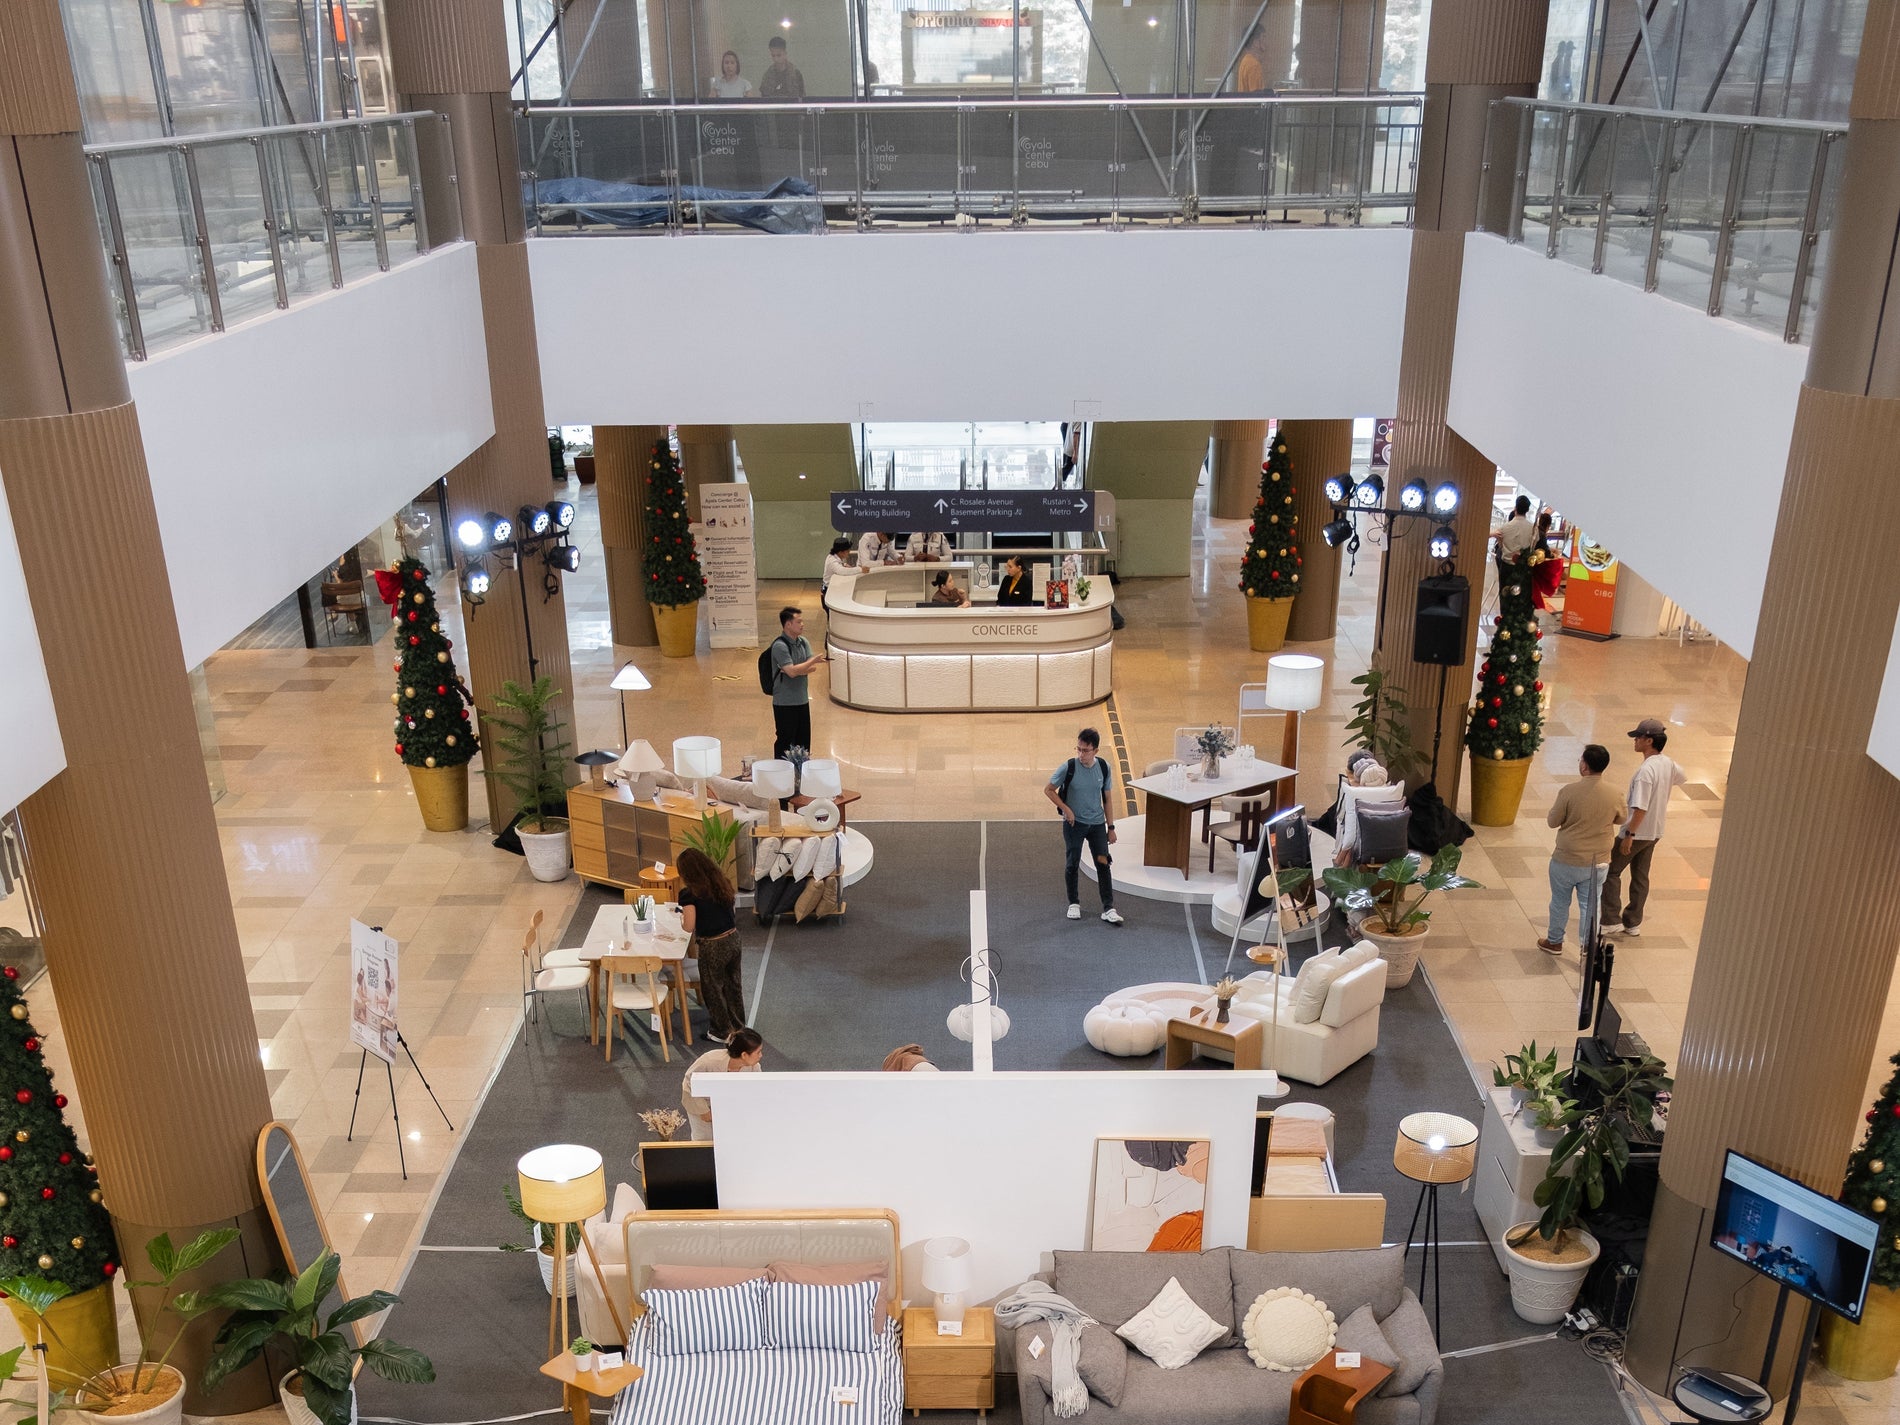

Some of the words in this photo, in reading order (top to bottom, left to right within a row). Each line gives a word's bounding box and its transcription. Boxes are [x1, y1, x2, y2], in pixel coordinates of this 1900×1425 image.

[710, 136, 741, 146] center
[710, 146, 735, 155] cebu
[1025, 150, 1056, 160] center
[1025, 160, 1049, 169] cebu
[959, 498, 986, 506] Rosales
[854, 509, 880, 518] Parking
[881, 509, 910, 518] Building
[950, 508, 985, 516] Basement
[986, 508, 1013, 517] Parking
[1050, 508, 1072, 516] Metro
[1099, 515, 1111, 527] L1
[1594, 589, 1613, 598] CIBO
[971, 624, 1038, 636] CONCIERGE
